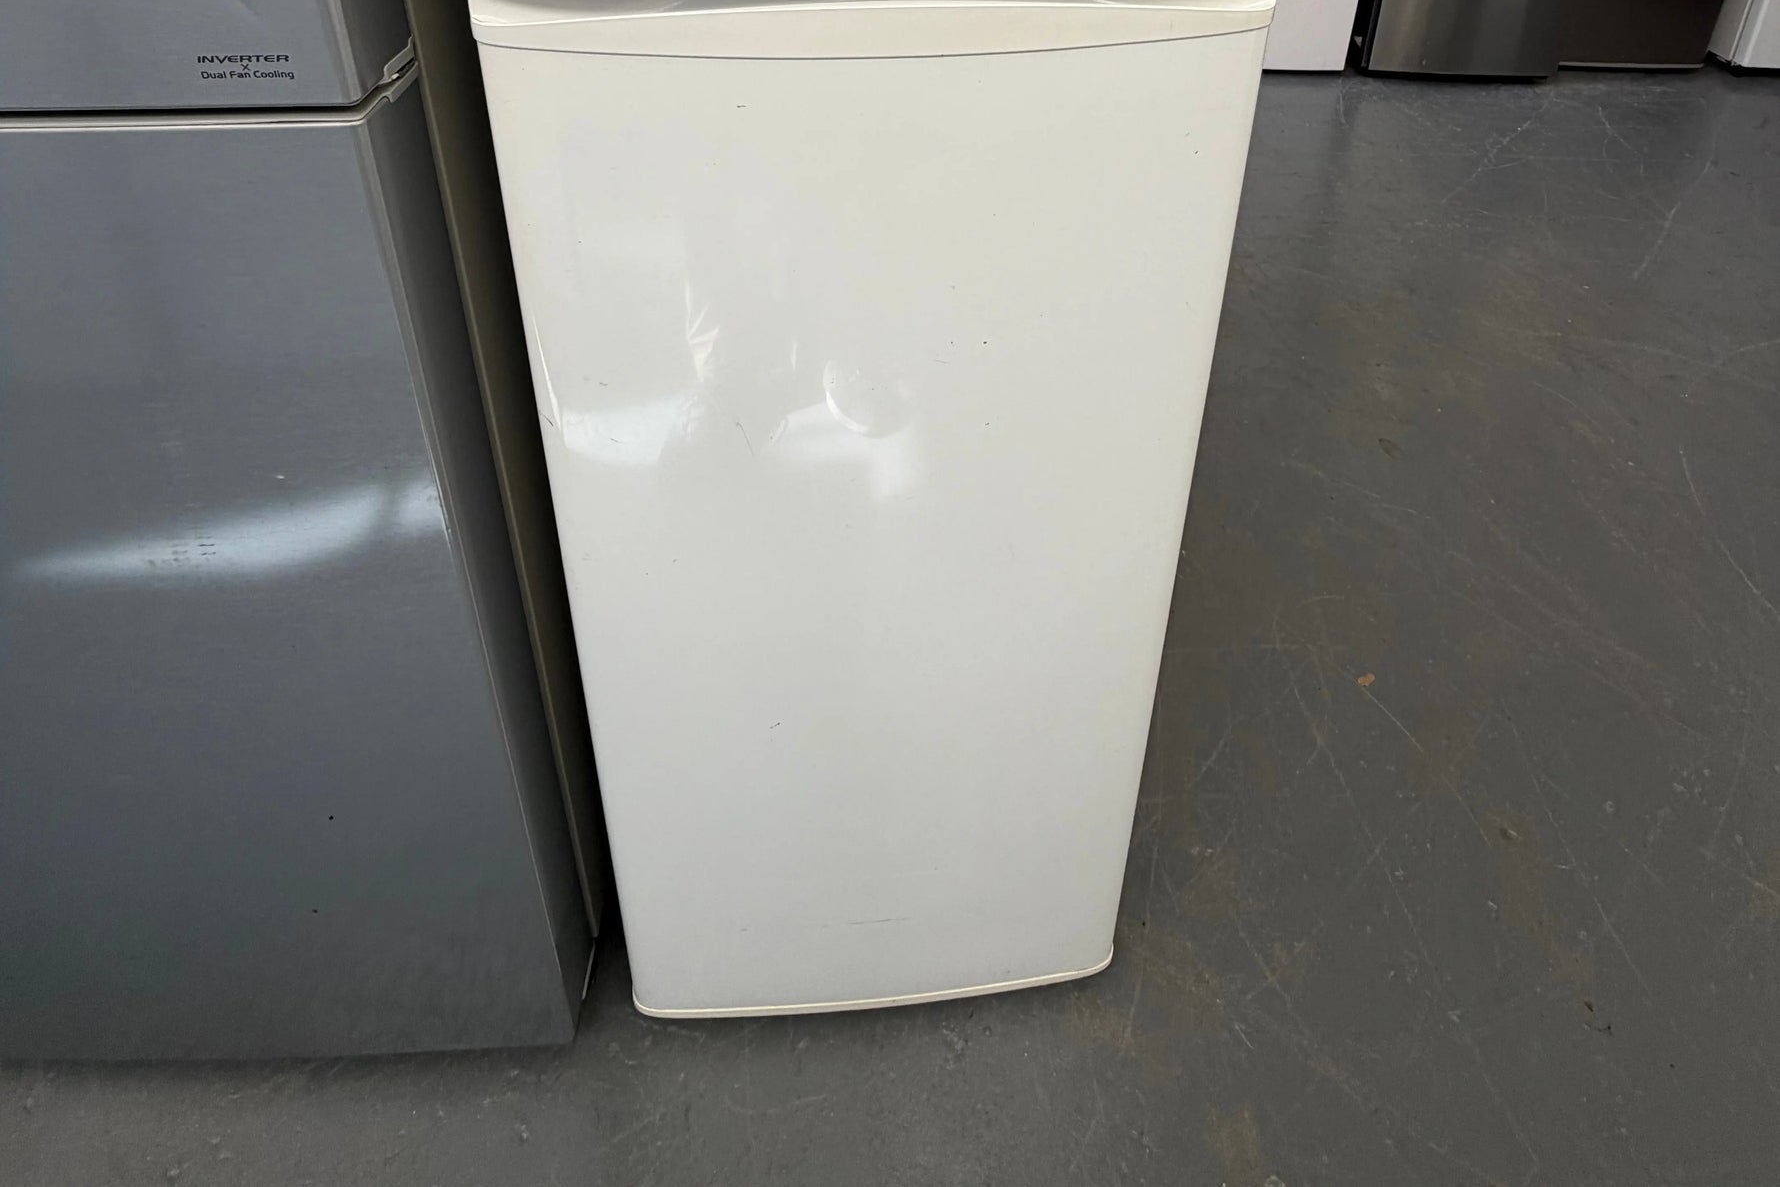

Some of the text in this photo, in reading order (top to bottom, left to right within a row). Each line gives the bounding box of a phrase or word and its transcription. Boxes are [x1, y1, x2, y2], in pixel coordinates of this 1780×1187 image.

[197, 55, 290, 64] INVERTER
[200, 70, 295, 80] Dual Fan Cooling
